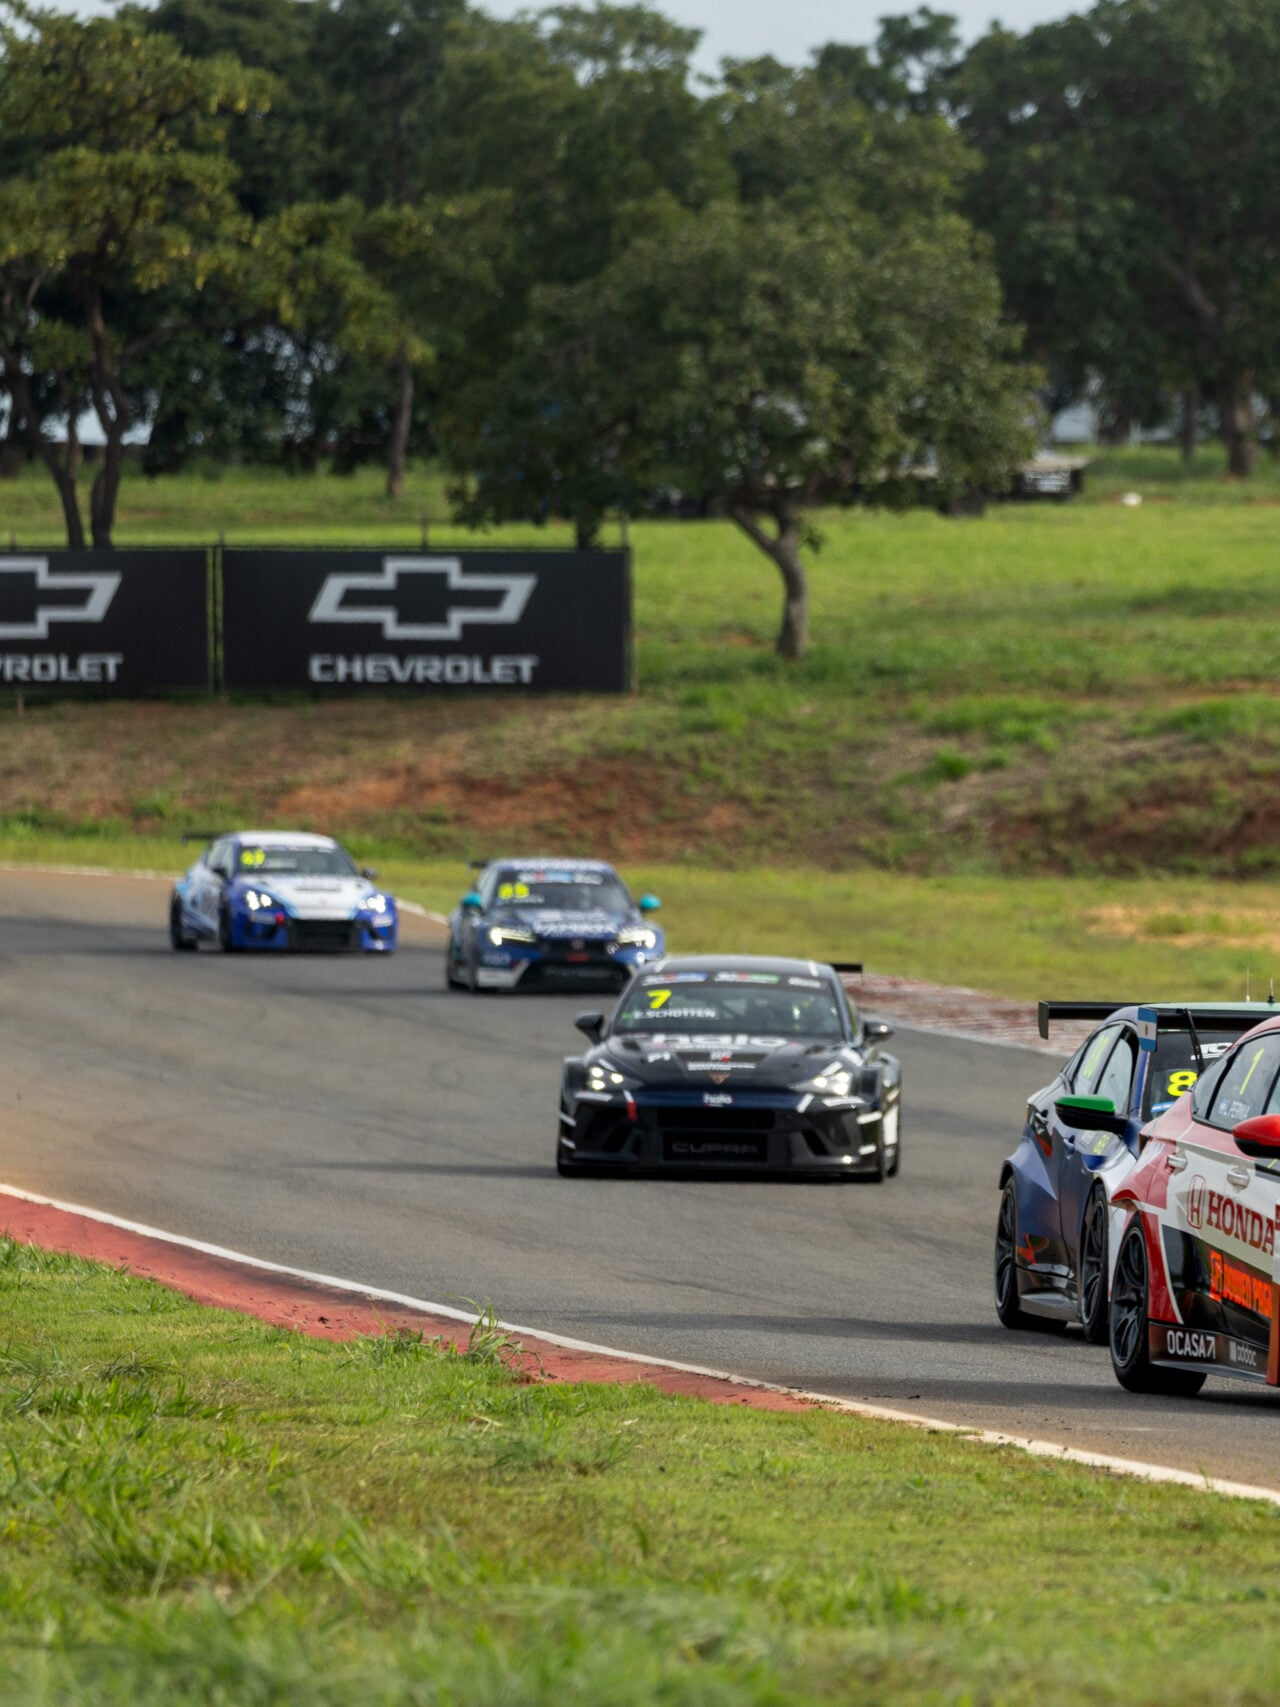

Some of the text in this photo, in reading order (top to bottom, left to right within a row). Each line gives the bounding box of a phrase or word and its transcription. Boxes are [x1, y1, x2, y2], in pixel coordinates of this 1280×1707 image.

[0, 653, 124, 682] ROLET
[309, 654, 540, 684] CHEVROLET
[647, 989, 672, 1009] 7
[1206, 1190, 1274, 1256] HONDA
[1166, 1329, 1207, 1358] OCASA
